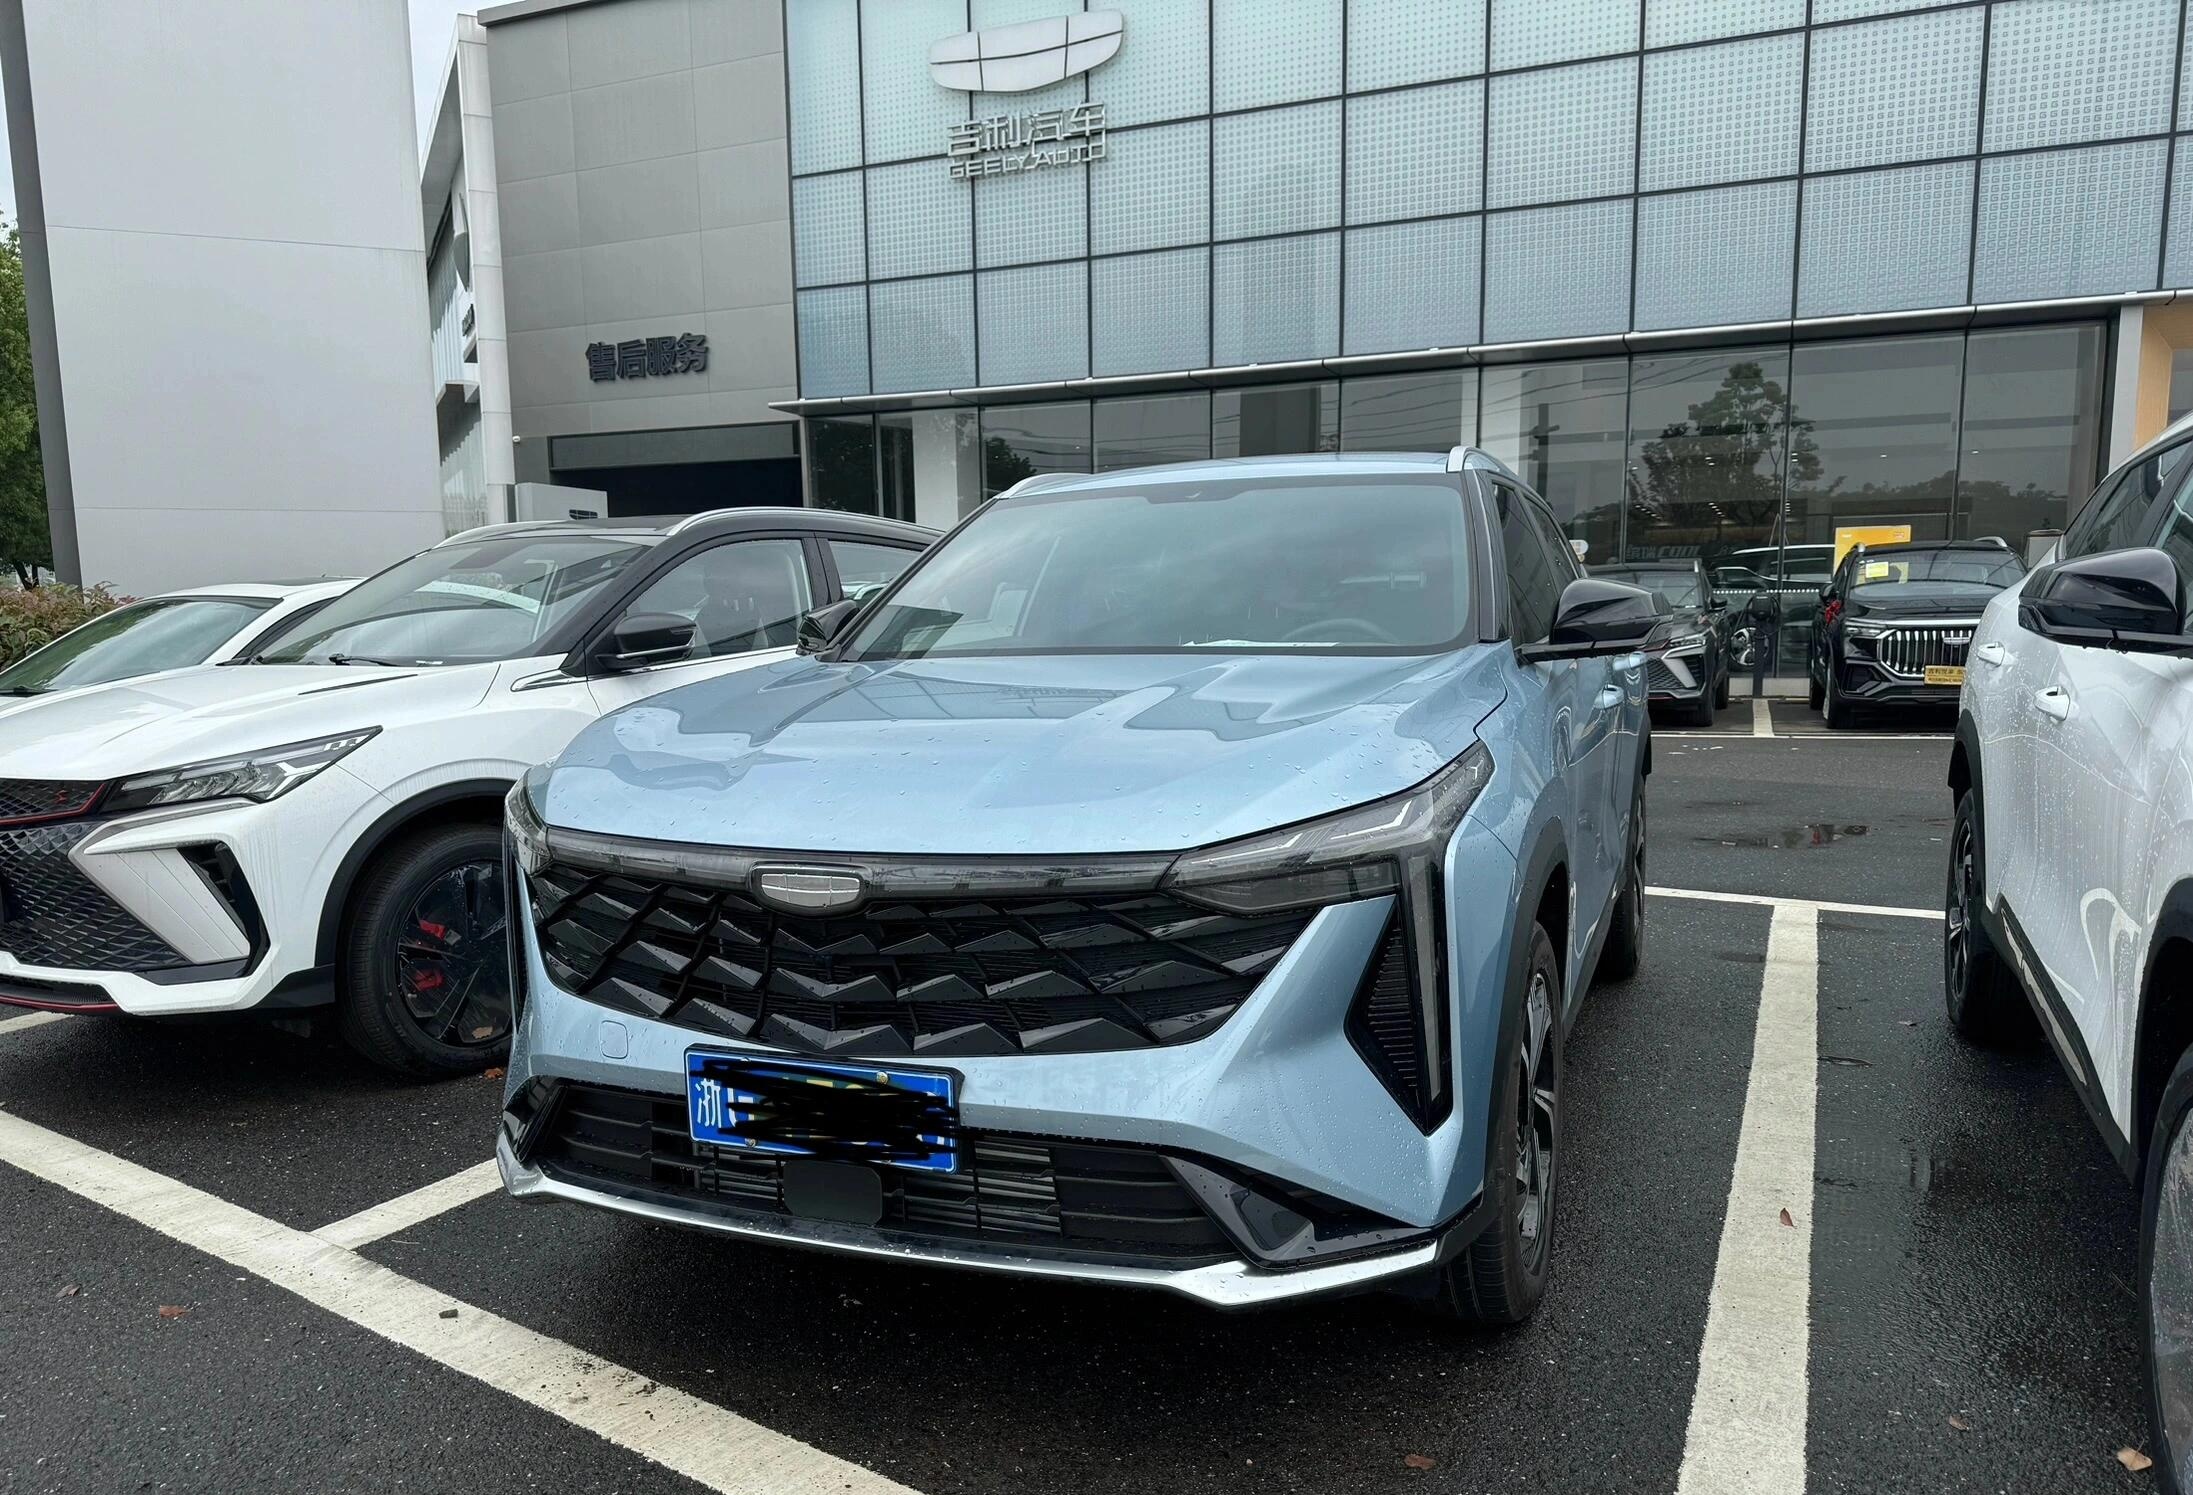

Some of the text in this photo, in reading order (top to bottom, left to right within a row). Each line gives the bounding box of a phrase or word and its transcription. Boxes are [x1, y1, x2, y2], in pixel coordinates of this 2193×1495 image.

[947, 101, 1105, 156] 吉利汽车
[949, 154, 1028, 180] GEELY
[585, 332, 709, 382] 售后服务
